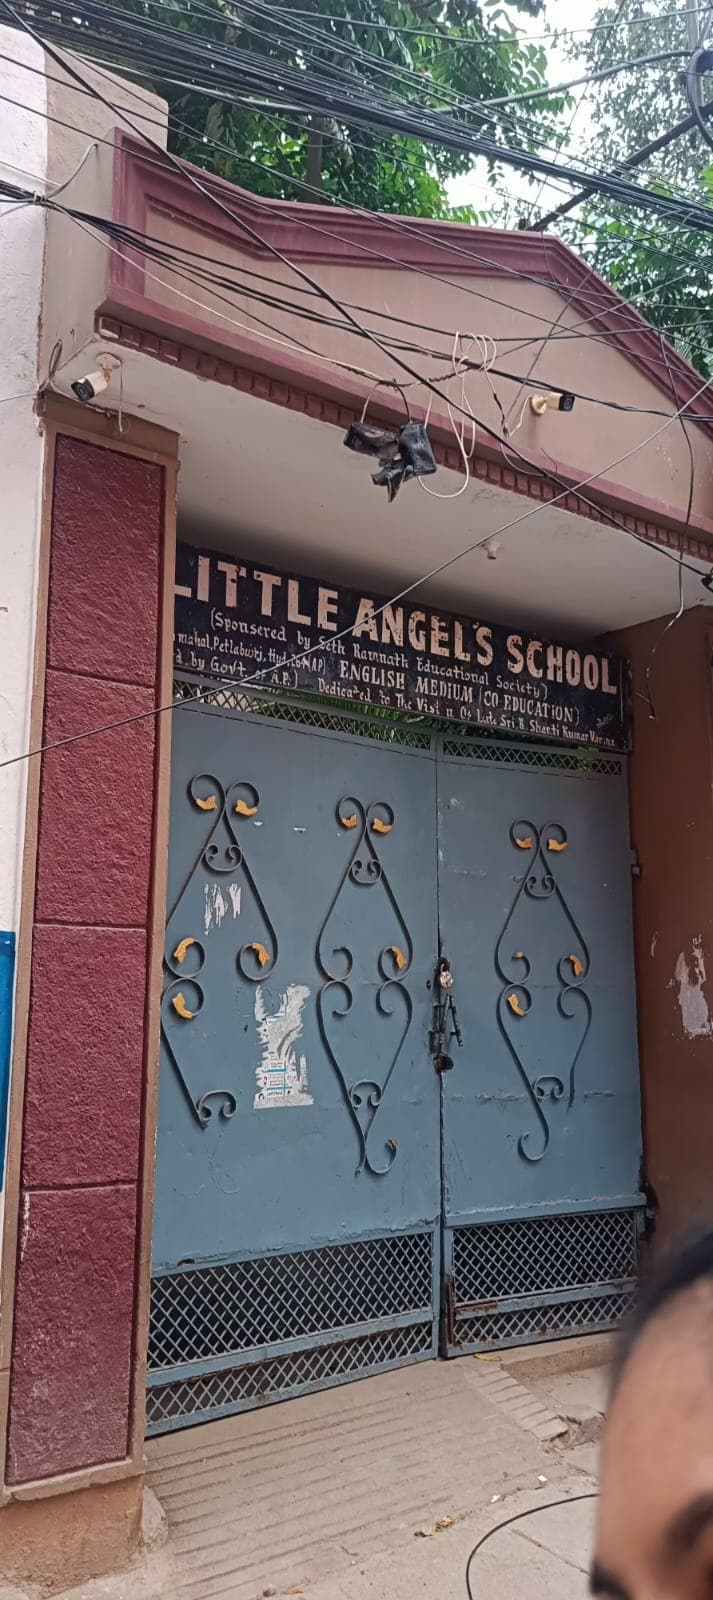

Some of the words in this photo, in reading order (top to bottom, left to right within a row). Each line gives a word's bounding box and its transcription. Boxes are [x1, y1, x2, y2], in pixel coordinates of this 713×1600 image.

[190, 651, 205, 671] by
[211, 607, 288, 642] (Sponsered
[297, 630, 311, 650] by
[318, 636, 346, 656] Seth
[353, 644, 409, 669] Ramnath
[416, 656, 489, 686] Educational
[496, 675, 548, 700] Society)
[352, 598, 494, 666] ANGEL'S
[507, 634, 618, 694] SCHOOL
[317, 677, 372, 703] Dedicated
[379, 690, 391, 706] to
[500, 714, 515, 729] Sri
[339, 660, 406, 690] ENGLISH
[415, 676, 473, 704] MEDIUM
[503, 694, 580, 726] EDUCATION)
